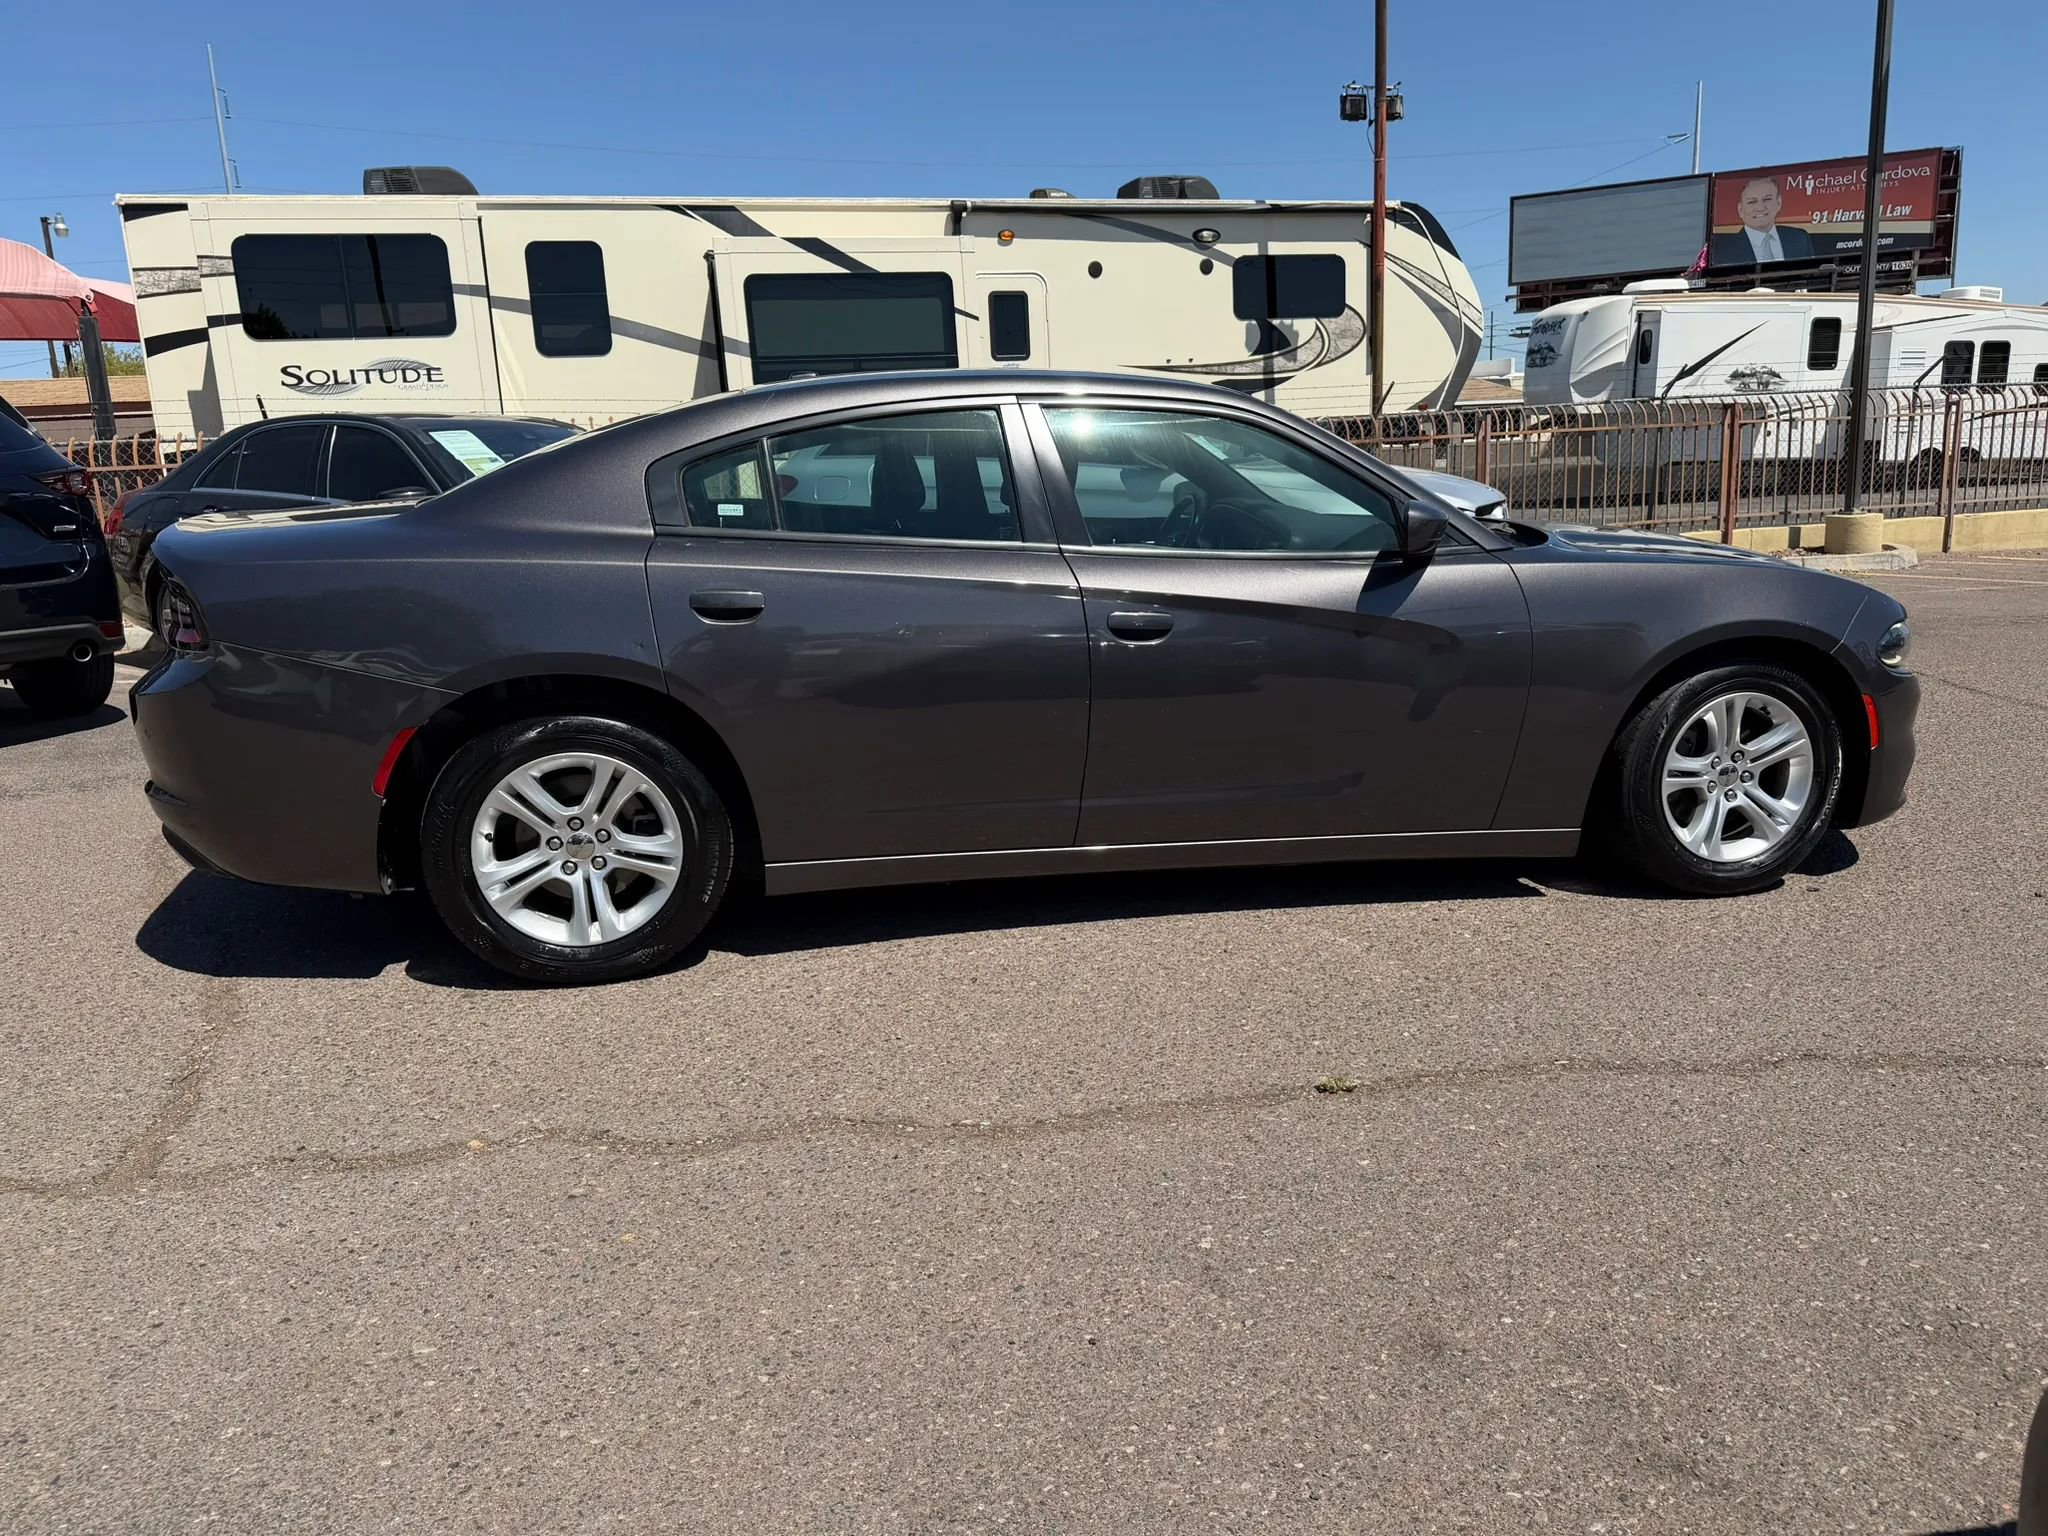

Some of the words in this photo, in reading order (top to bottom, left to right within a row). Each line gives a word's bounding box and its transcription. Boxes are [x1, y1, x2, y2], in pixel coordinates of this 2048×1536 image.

[1786, 170, 1857, 195] Michael
[1815, 186, 1846, 195] INJURY
[1849, 180, 1900, 191] ATTEYS
[1886, 203, 1913, 217] Law
[280, 365, 445, 387] SOLITUDE
